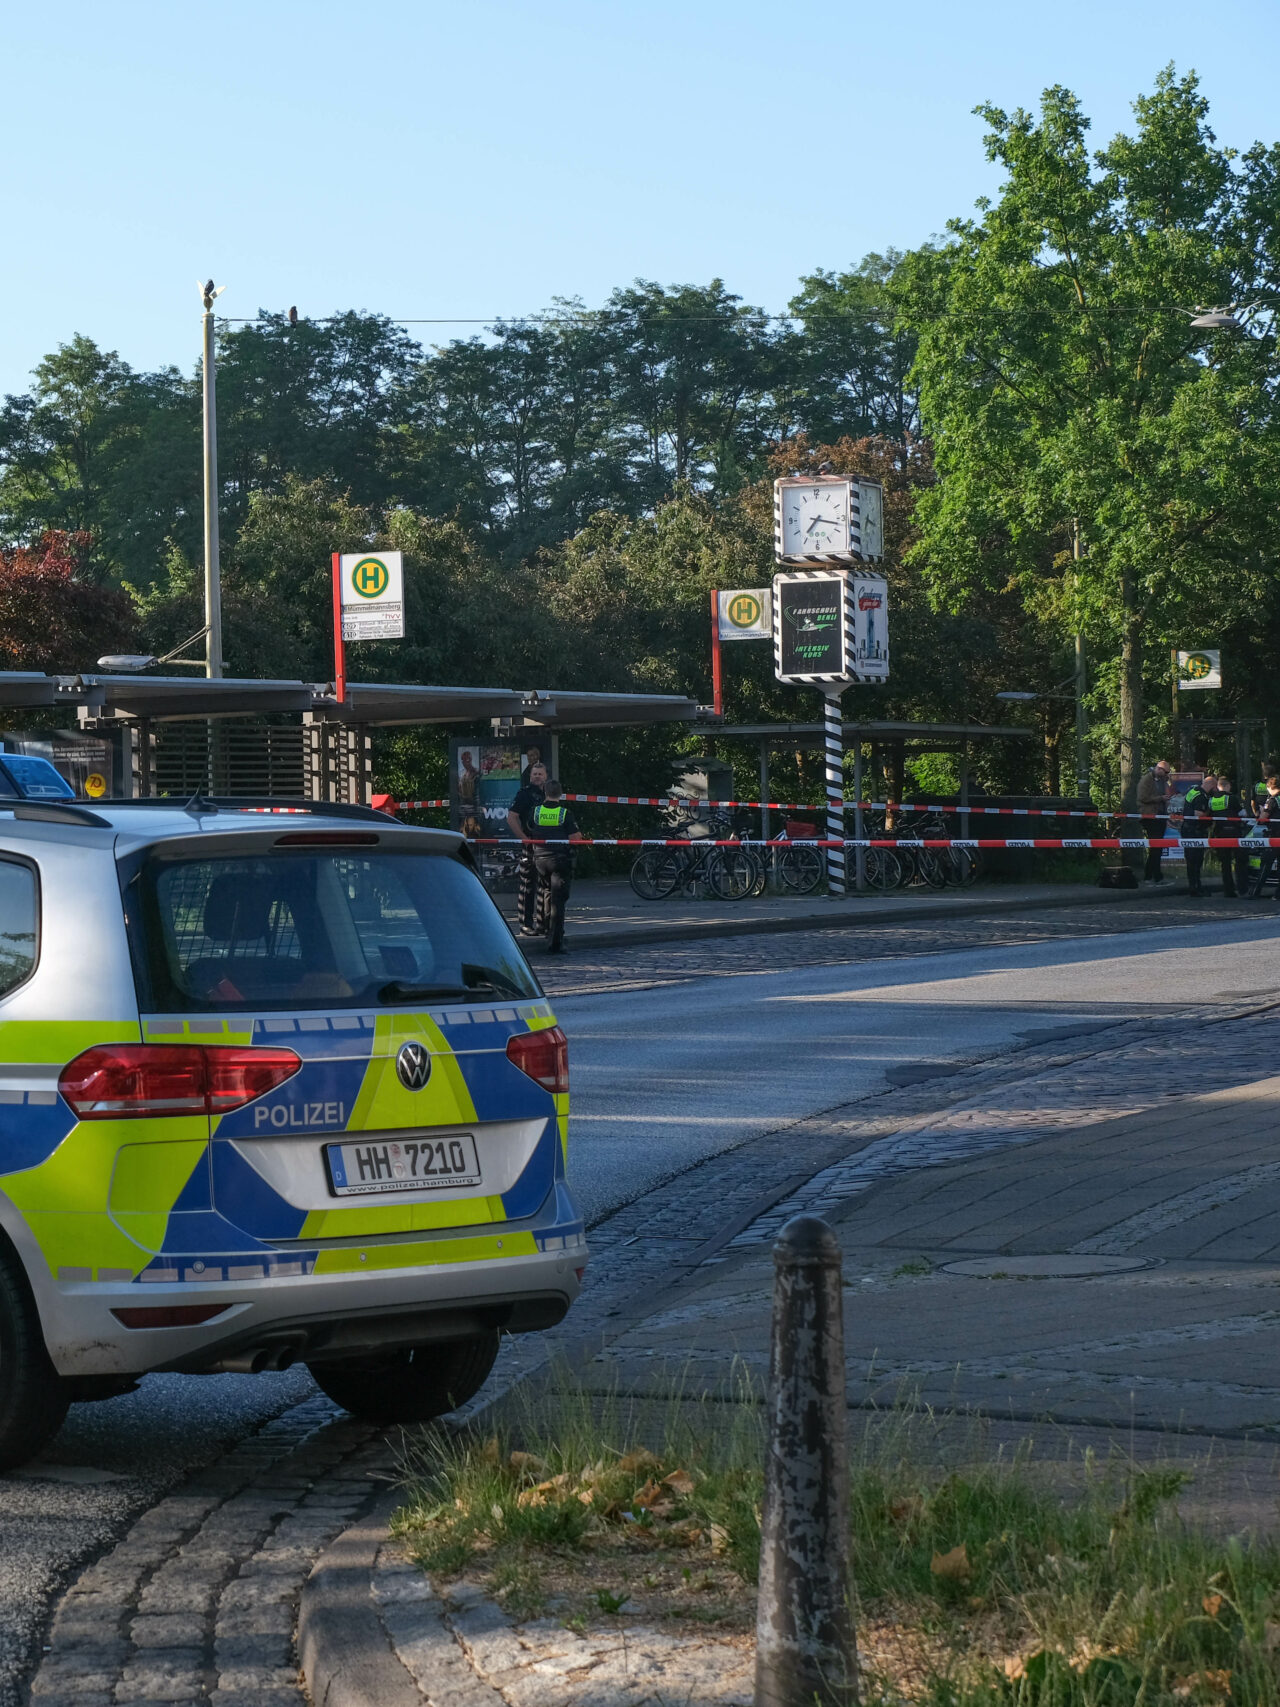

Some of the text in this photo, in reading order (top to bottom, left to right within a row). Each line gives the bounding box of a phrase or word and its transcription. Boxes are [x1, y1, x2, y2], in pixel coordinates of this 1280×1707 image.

[815, 543, 820, 551] 6
[362, 567, 379, 589] H
[737, 602, 752, 620] H
[254, 1102, 344, 1128] POLIZEI
[356, 1141, 466, 1180] HH 7210
[335, 1172, 342, 1181] D
[347, 1178, 474, 1193] www.polizei.hamburg
